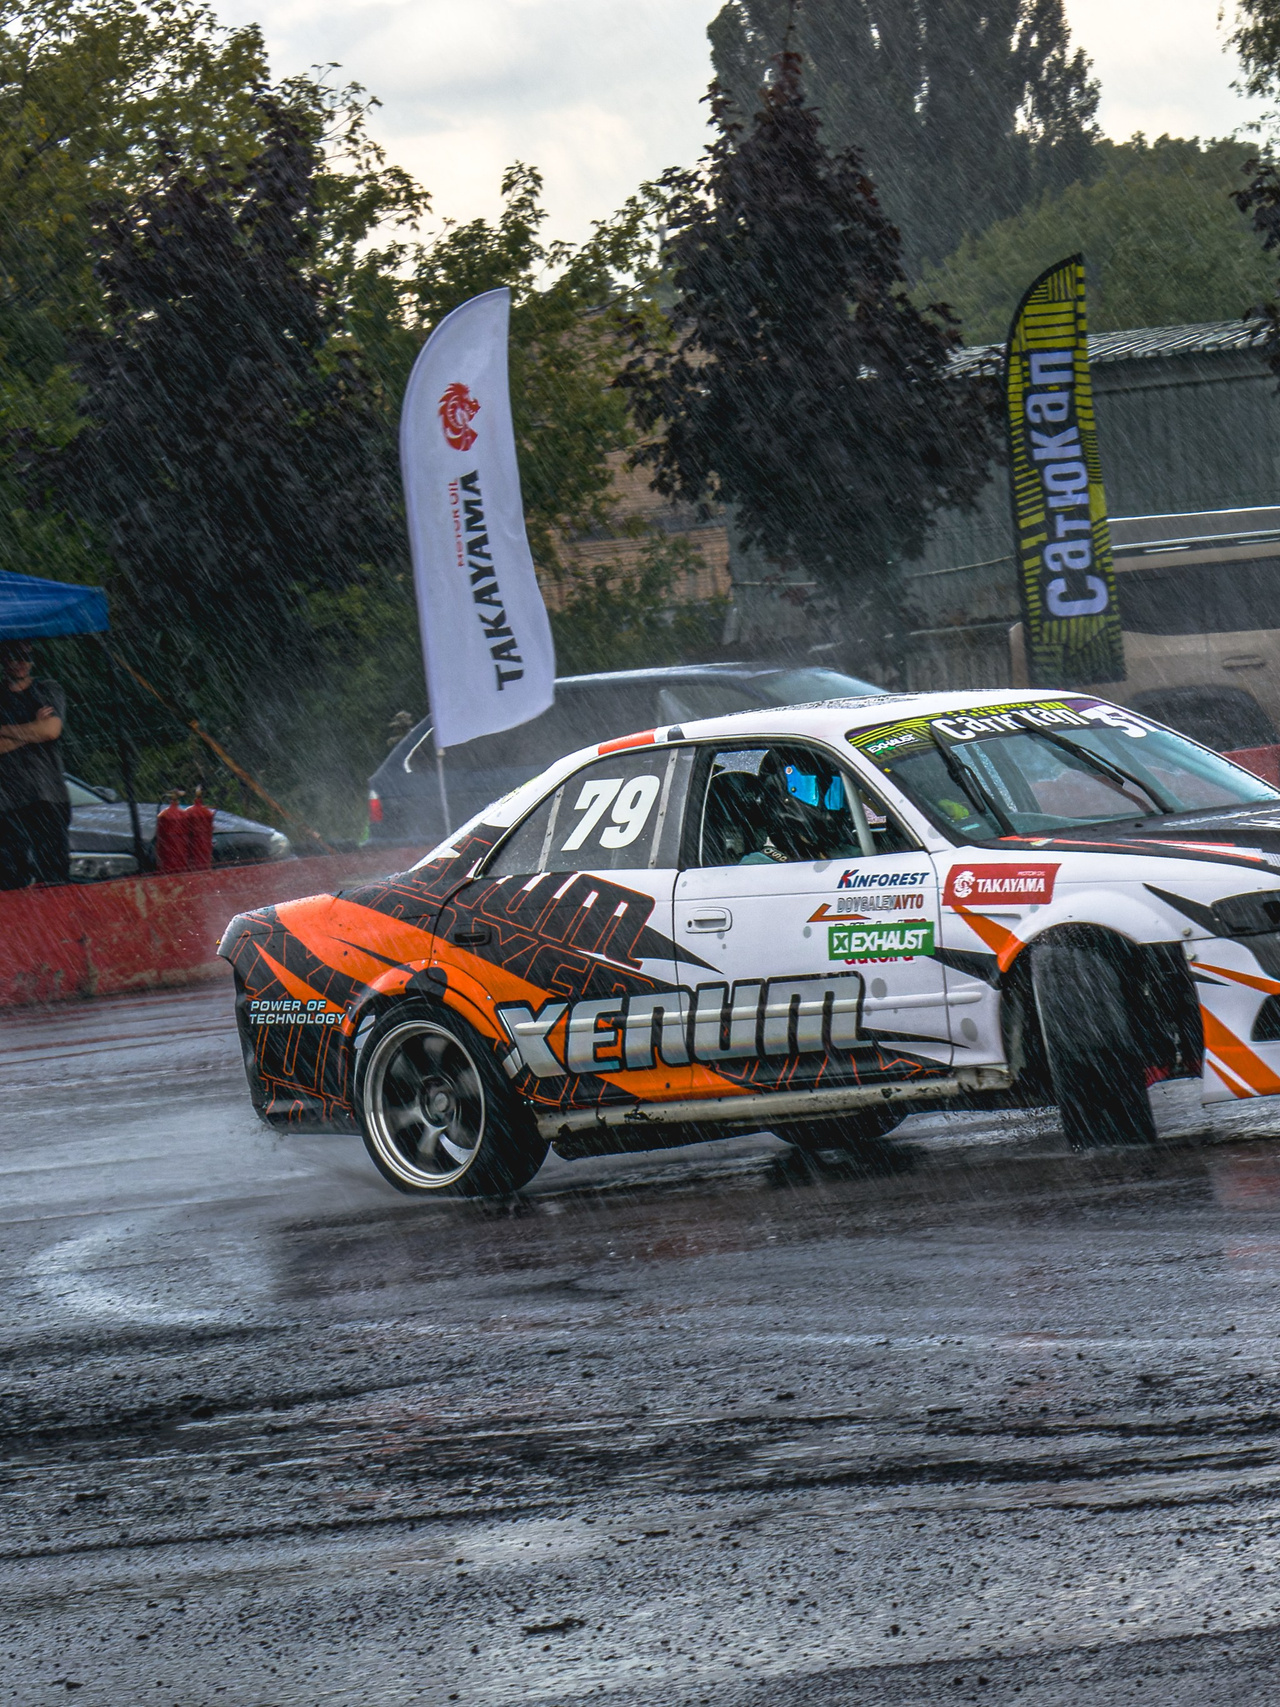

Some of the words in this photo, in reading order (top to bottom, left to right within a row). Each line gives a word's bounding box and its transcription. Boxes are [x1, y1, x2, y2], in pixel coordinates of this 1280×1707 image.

[460, 469, 524, 691] TAKAYAMA
[560, 774, 661, 852] 79
[836, 869, 931, 889] KINFOREST
[976, 878, 1046, 893] TAKAYAMA
[850, 929, 929, 953] EXHAUST
[250, 1000, 302, 1011] POWER
[306, 1000, 327, 1011] OF
[249, 1013, 346, 1024] TECHNOLOGY
[497, 973, 875, 1080] XENUM
